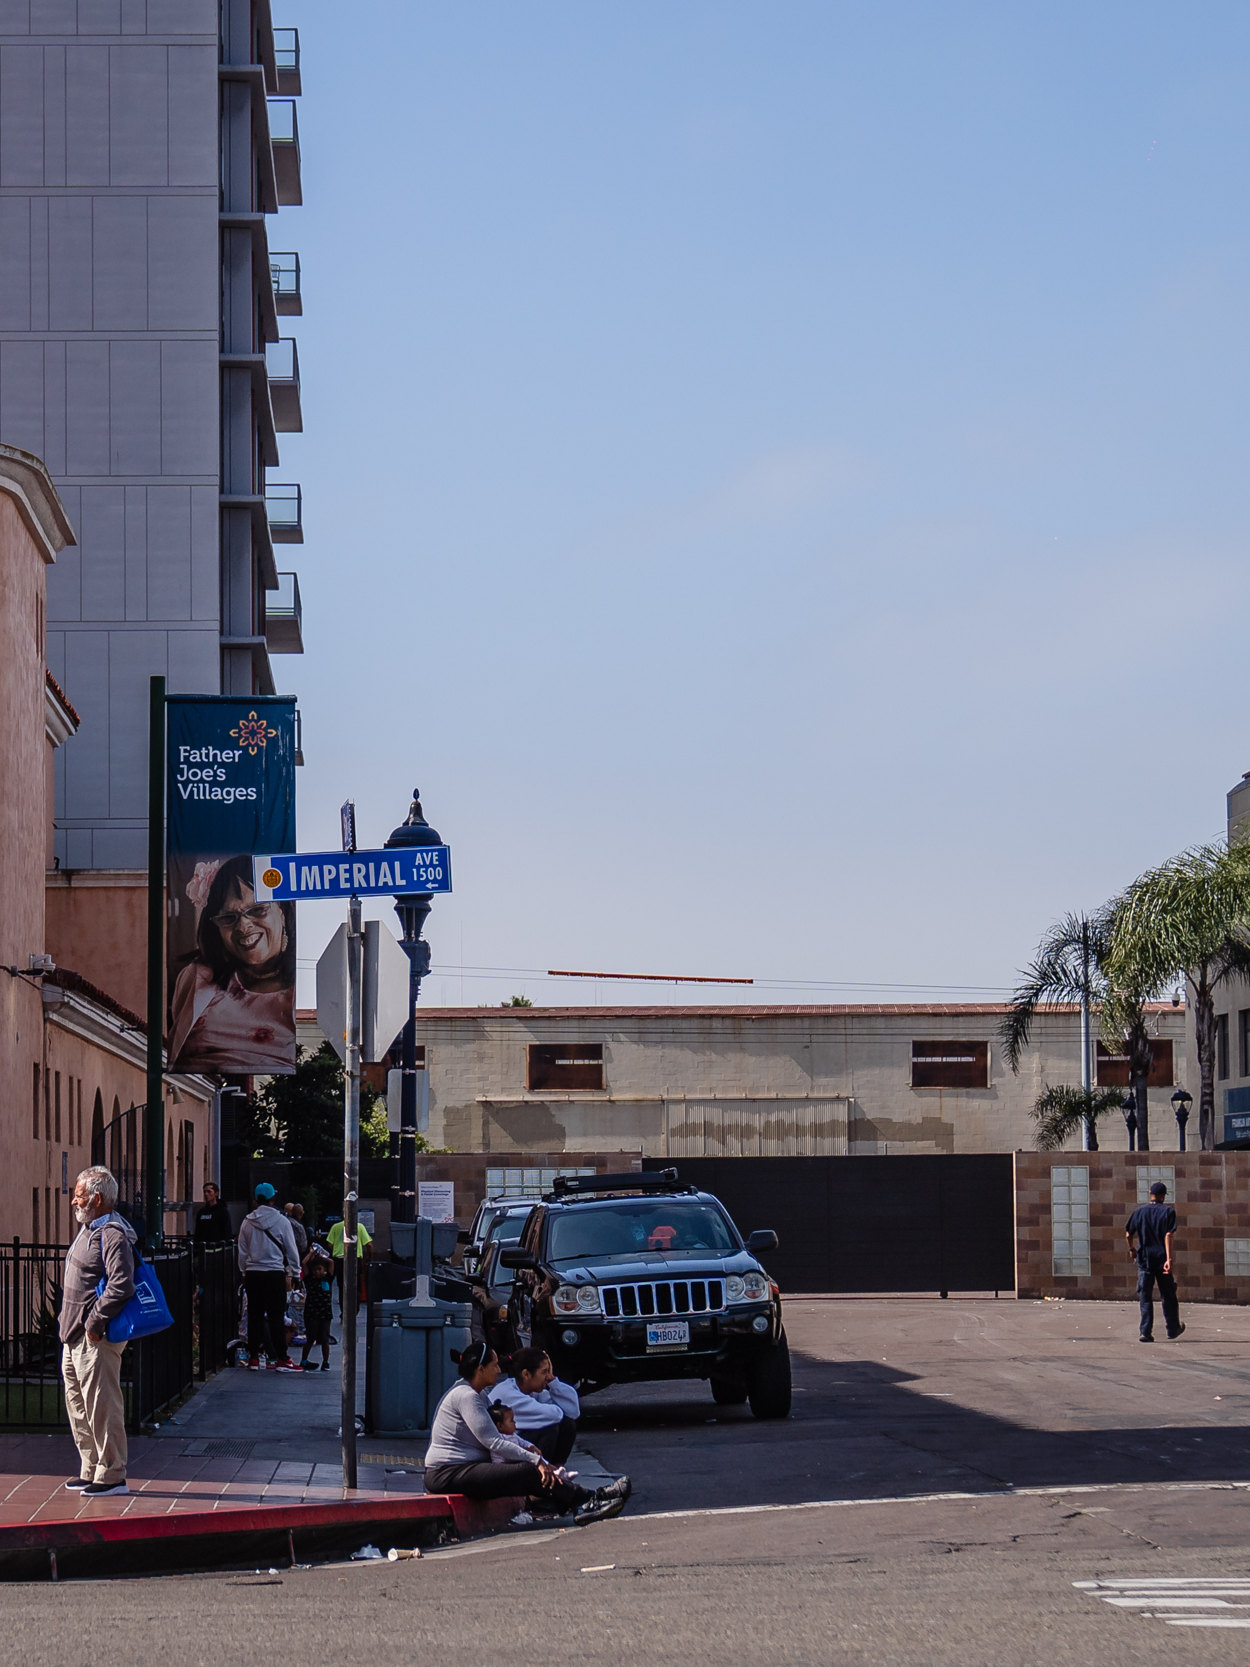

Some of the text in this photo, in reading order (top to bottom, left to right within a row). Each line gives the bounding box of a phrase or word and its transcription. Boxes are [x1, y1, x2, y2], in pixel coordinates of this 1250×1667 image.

[178, 746, 242, 762] Father
[176, 764, 226, 781] Joe's
[177, 783, 257, 804] Villages
[415, 852, 439, 866] AVE
[288, 861, 406, 892] IMPERIAL
[412, 866, 443, 881] 1500
